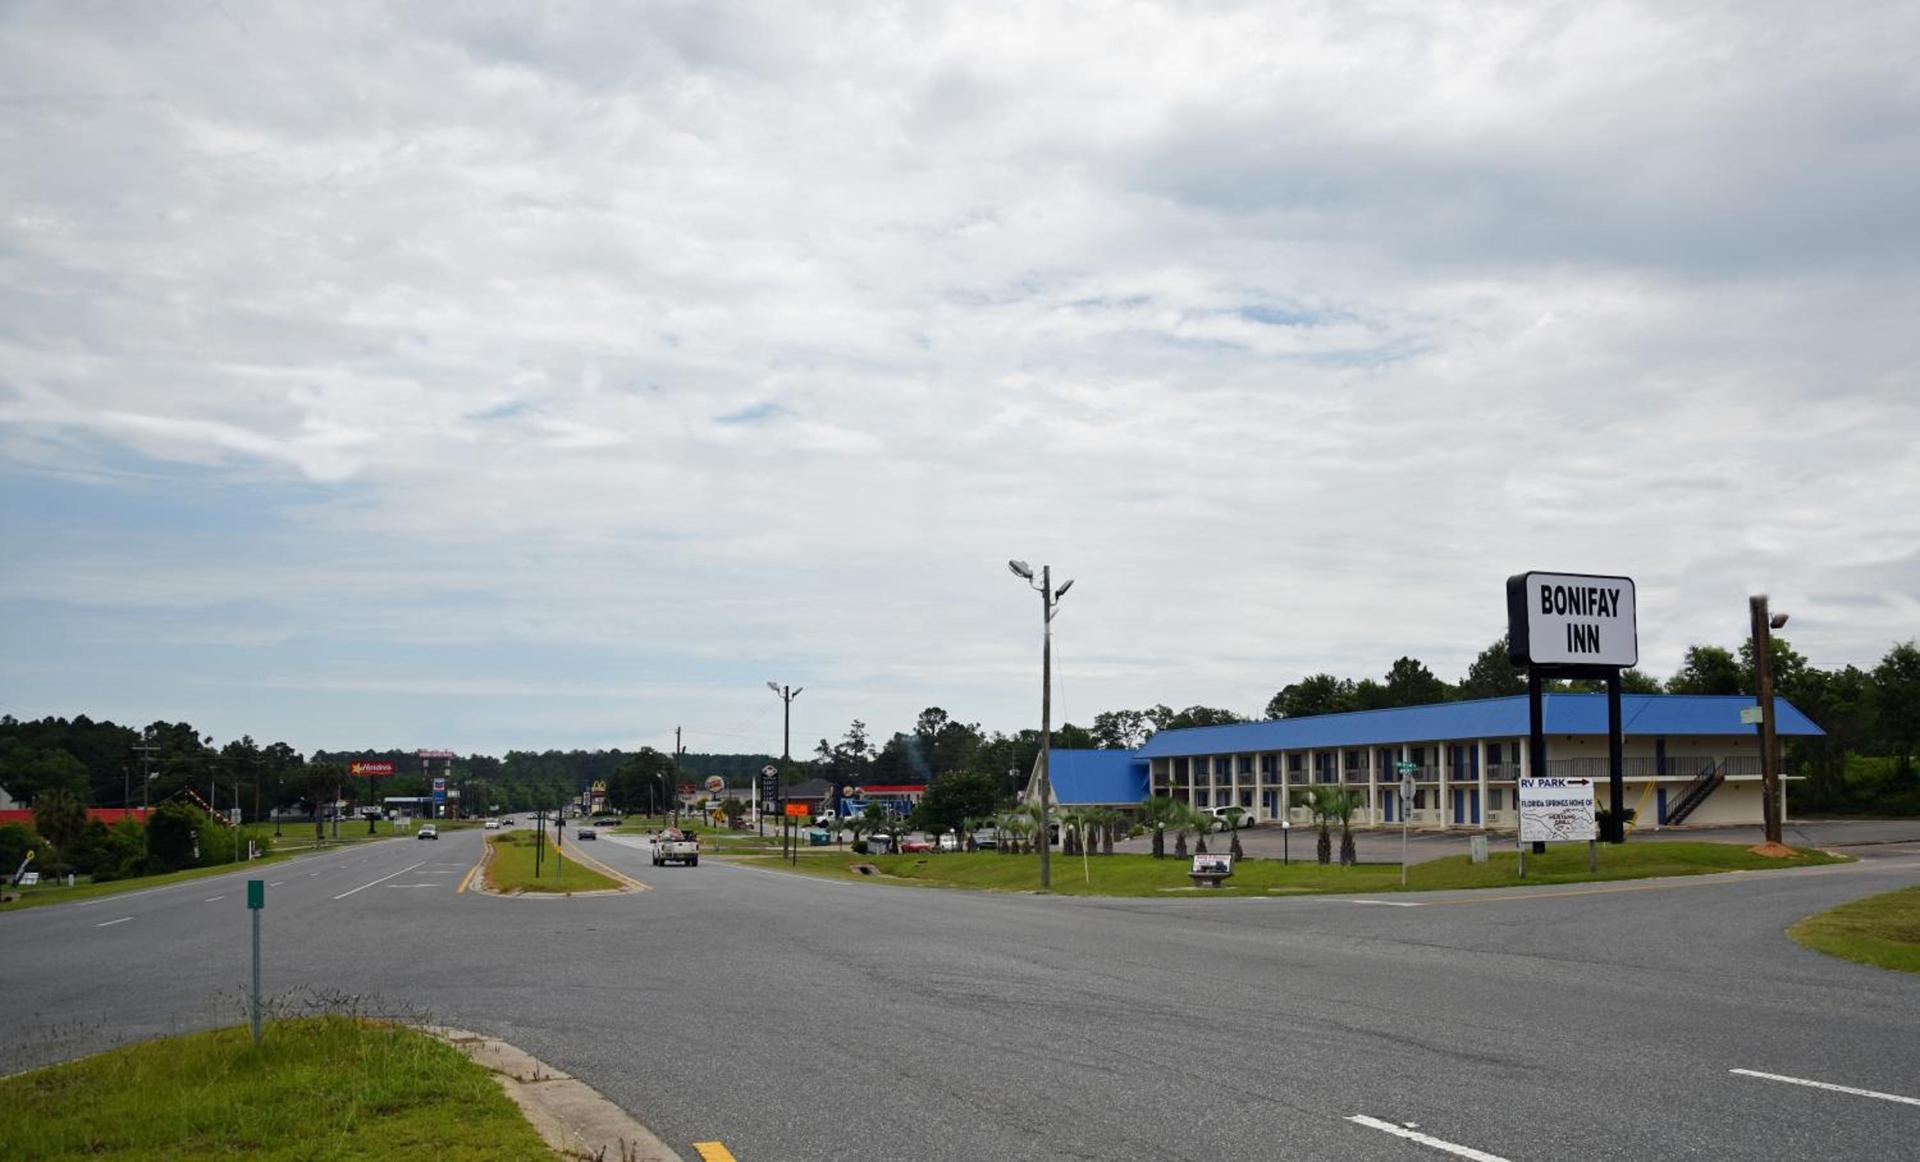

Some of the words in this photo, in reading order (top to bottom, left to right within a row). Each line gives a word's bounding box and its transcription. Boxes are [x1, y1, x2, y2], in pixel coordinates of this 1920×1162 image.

[1540, 585, 1620, 617] BONIFAY
[1567, 623, 1601, 653] INN
[1521, 779, 1534, 788] RV
[1538, 779, 1566, 787] PARK
